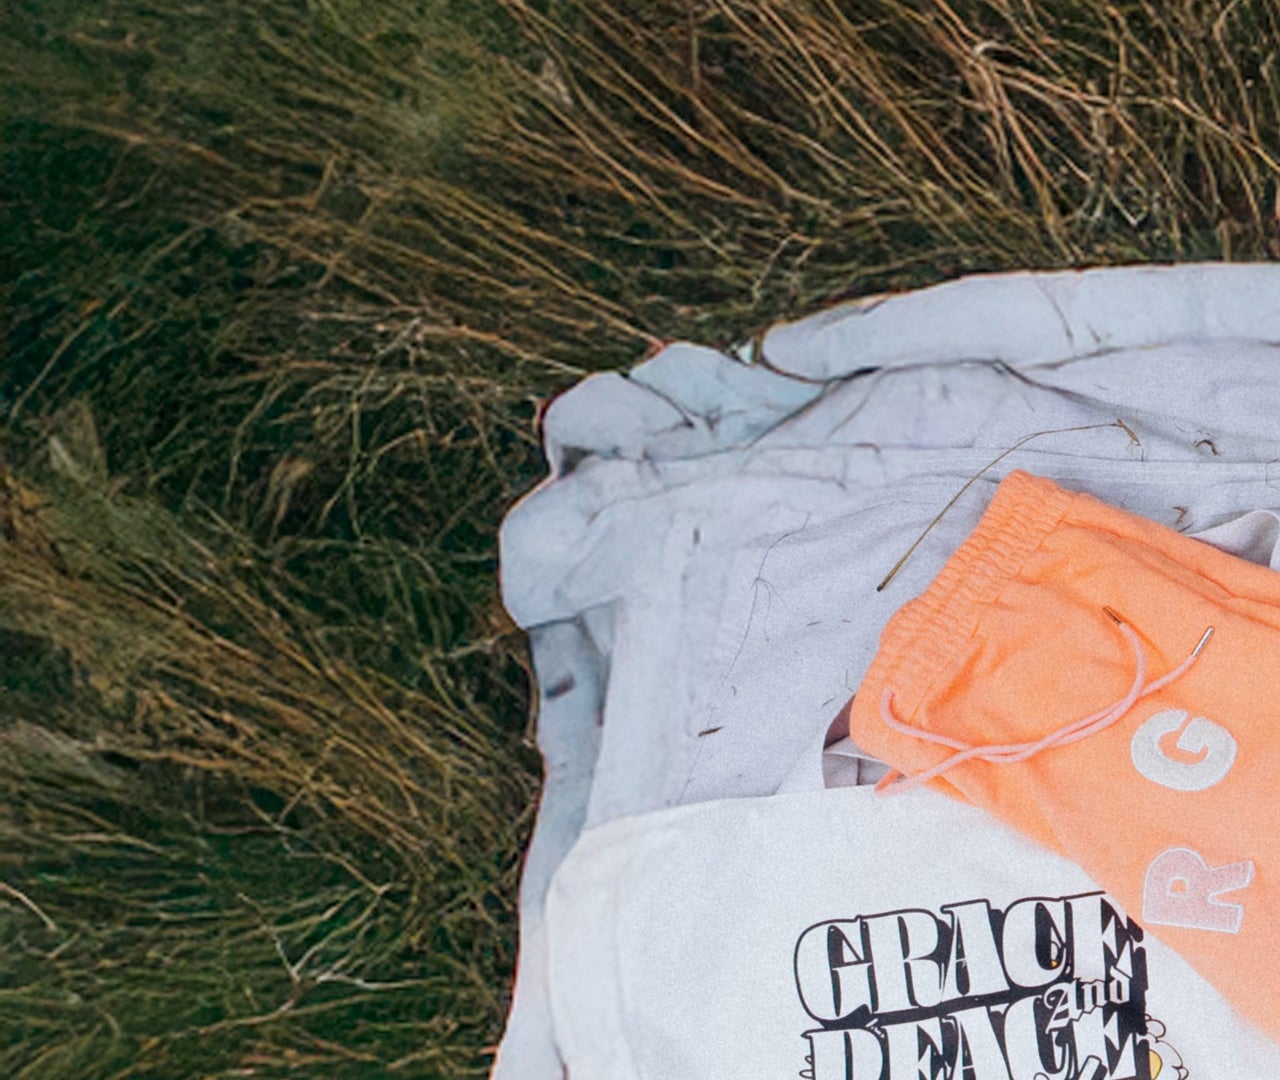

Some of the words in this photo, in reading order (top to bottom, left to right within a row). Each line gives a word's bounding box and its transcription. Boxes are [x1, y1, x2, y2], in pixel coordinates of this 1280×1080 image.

[1131, 708, 1238, 791] G
[1142, 847, 1255, 934] R
[794, 890, 1147, 1022] GRACE
